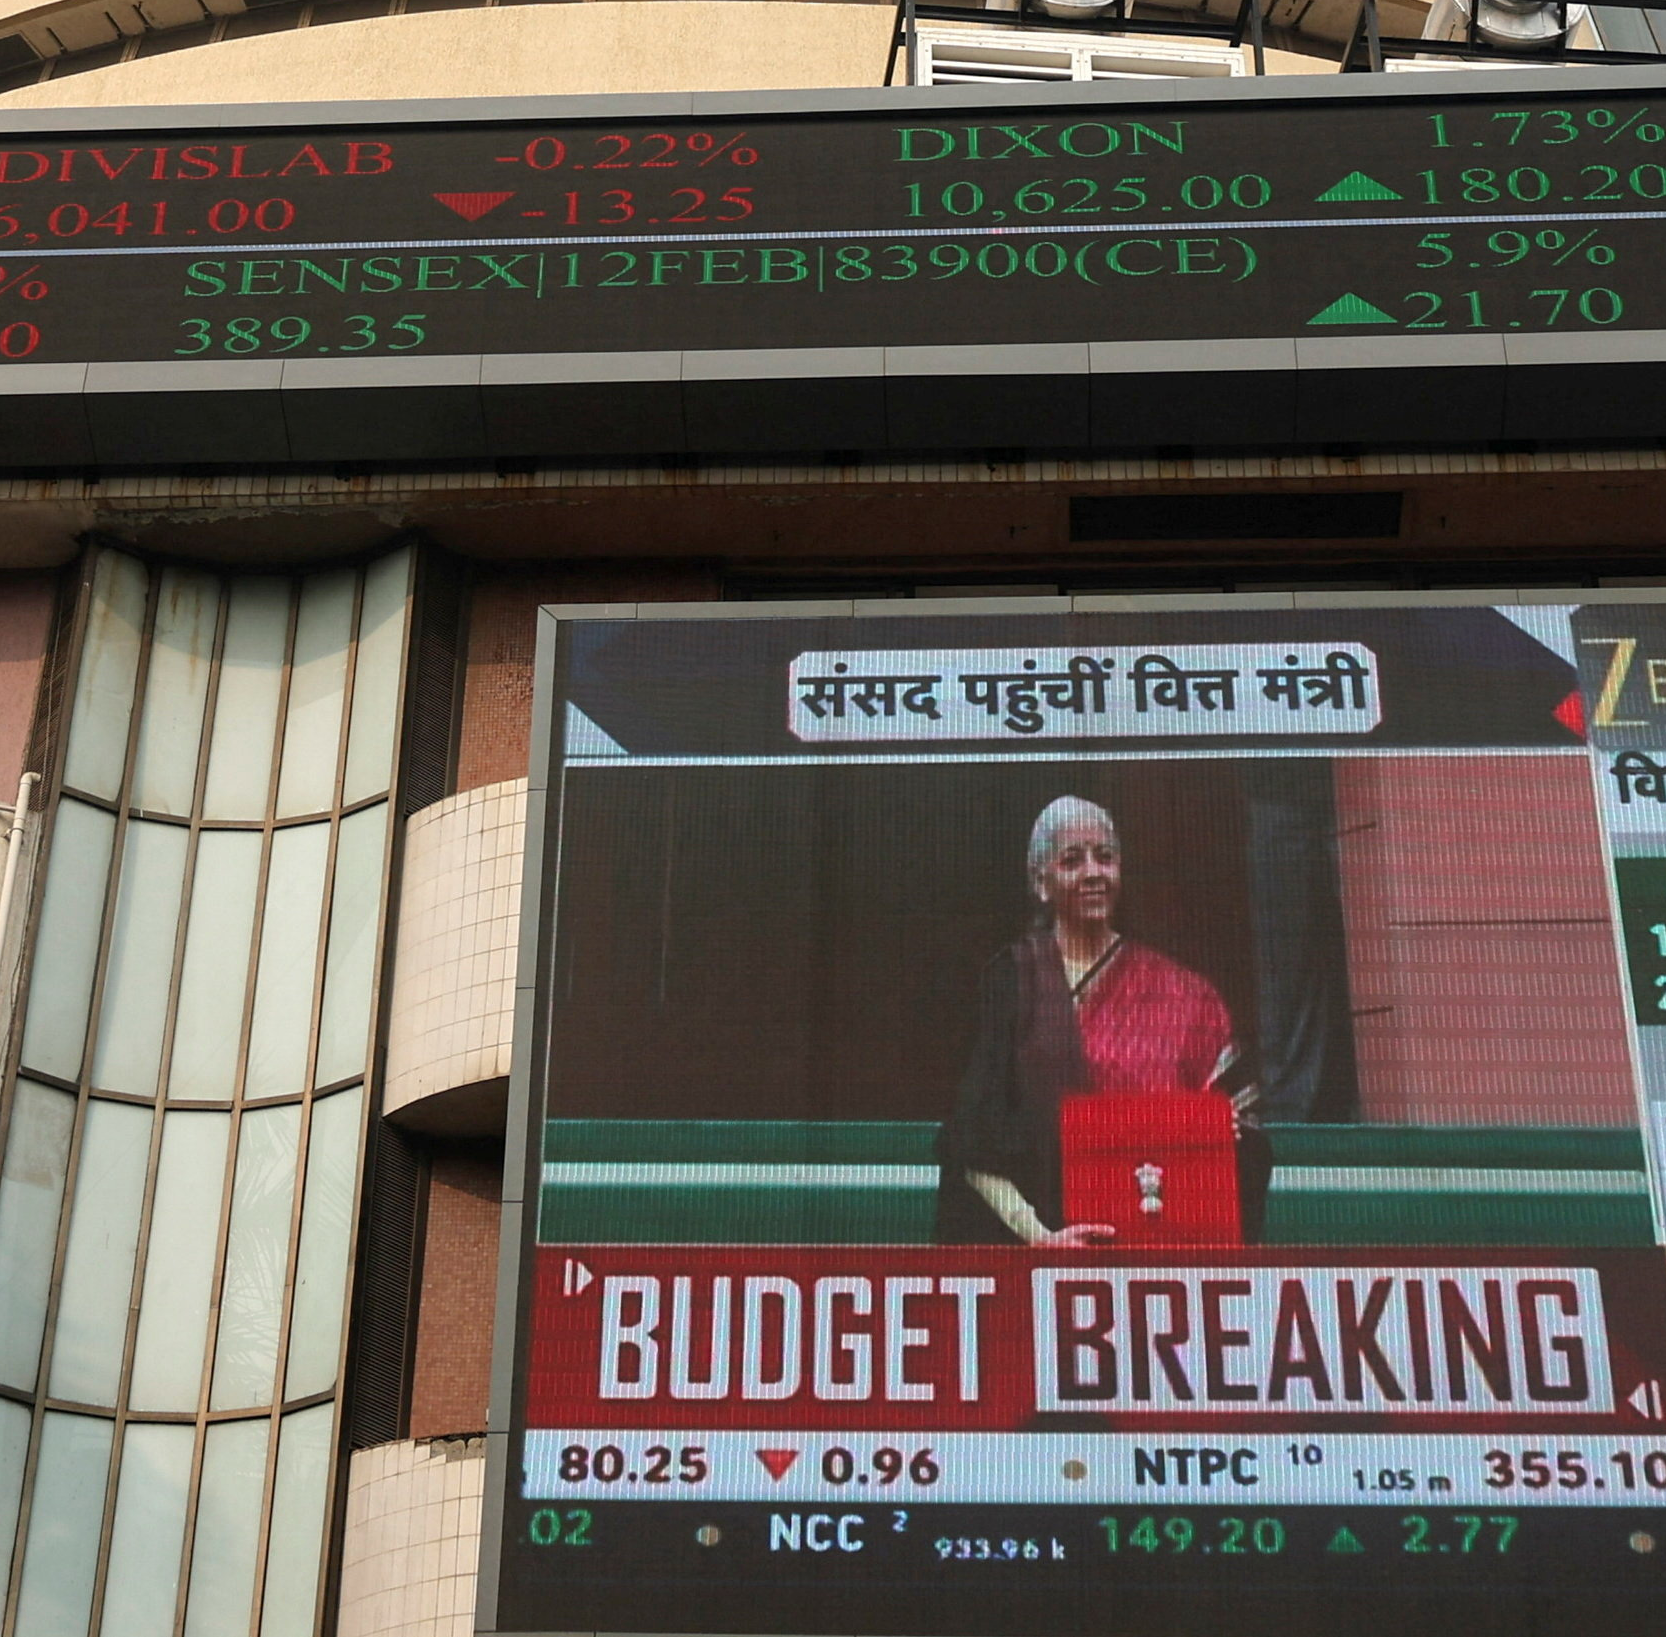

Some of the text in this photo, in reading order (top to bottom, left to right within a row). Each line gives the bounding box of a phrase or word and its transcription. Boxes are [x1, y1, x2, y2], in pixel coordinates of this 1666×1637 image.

[495, 132, 760, 170] -0.22%
[897, 121, 1186, 162] DIXON
[1430, 107, 1666, 148] 1.73%
[520, 186, 755, 226] -13.25
[905, 173, 1273, 221] 10,625.00
[1416, 229, 1617, 269] 5.9%
[175, 313, 427, 355] 389.35
[1404, 287, 1625, 329] 21.70
[798, 663, 942, 719] संसद
[1127, 654, 1240, 712] वित्त
[1256, 653, 1369, 711] मंत्री
[599, 1275, 1590, 1403] BUDGET BREAKING
[558, 1445, 708, 1485] 80.25
[821, 1446, 940, 1487] 0.96
[1133, 1447, 1259, 1487] NTPC
[1286, 1443, 1323, 1466] 10
[1353, 1468, 1416, 1492] 1.05
[1427, 1475, 1452, 1493] m
[770, 1513, 864, 1552] NCC
[892, 1510, 909, 1533] 2
[1051, 1537, 1066, 1560] k
[1099, 1515, 1287, 1555] 149.20
[1402, 1514, 1520, 1554] 2.77
